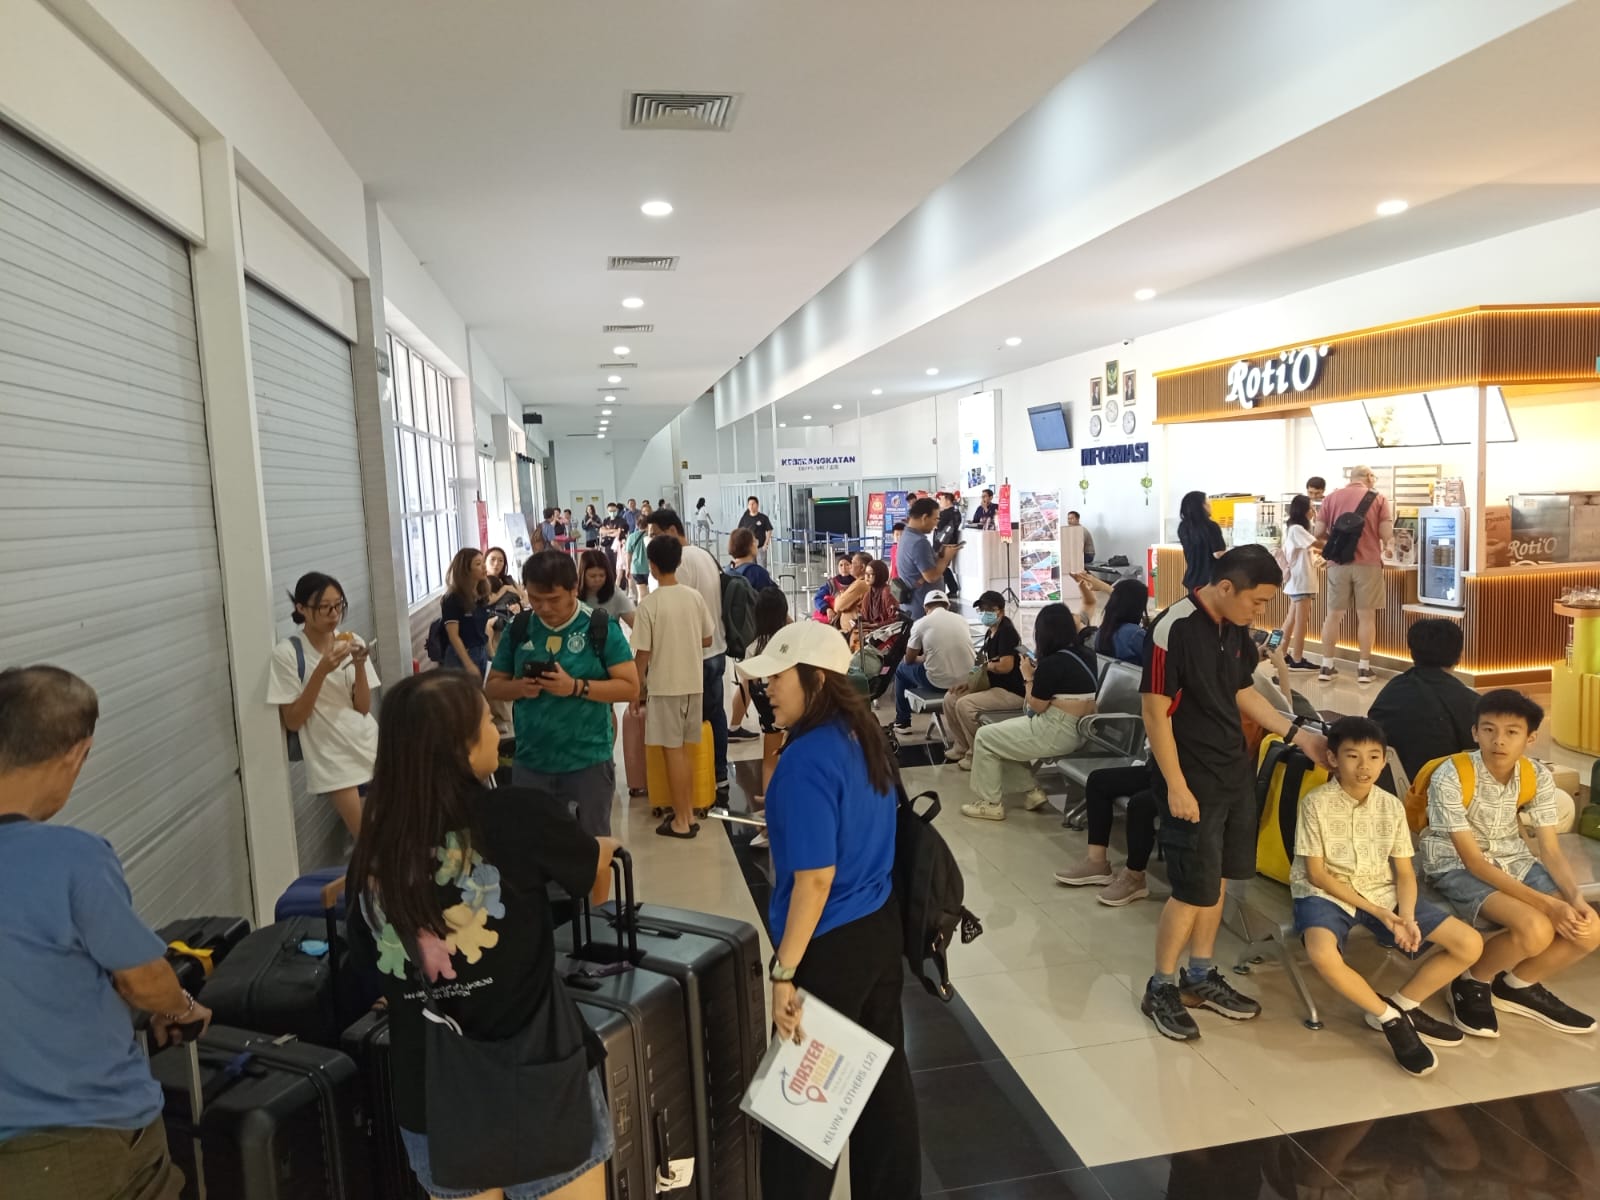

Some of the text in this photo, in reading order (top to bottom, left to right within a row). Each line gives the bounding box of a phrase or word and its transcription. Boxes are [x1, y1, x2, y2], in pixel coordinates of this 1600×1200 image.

[1081, 442, 1149, 467] INFORMASI
[789, 1040, 825, 1096] MASTER
[863, 1051, 879, 1073] (12)
[843, 1071, 867, 1105] OTHERS
[840, 1106, 849, 1117] &
[822, 1114, 844, 1146] KELVIN
